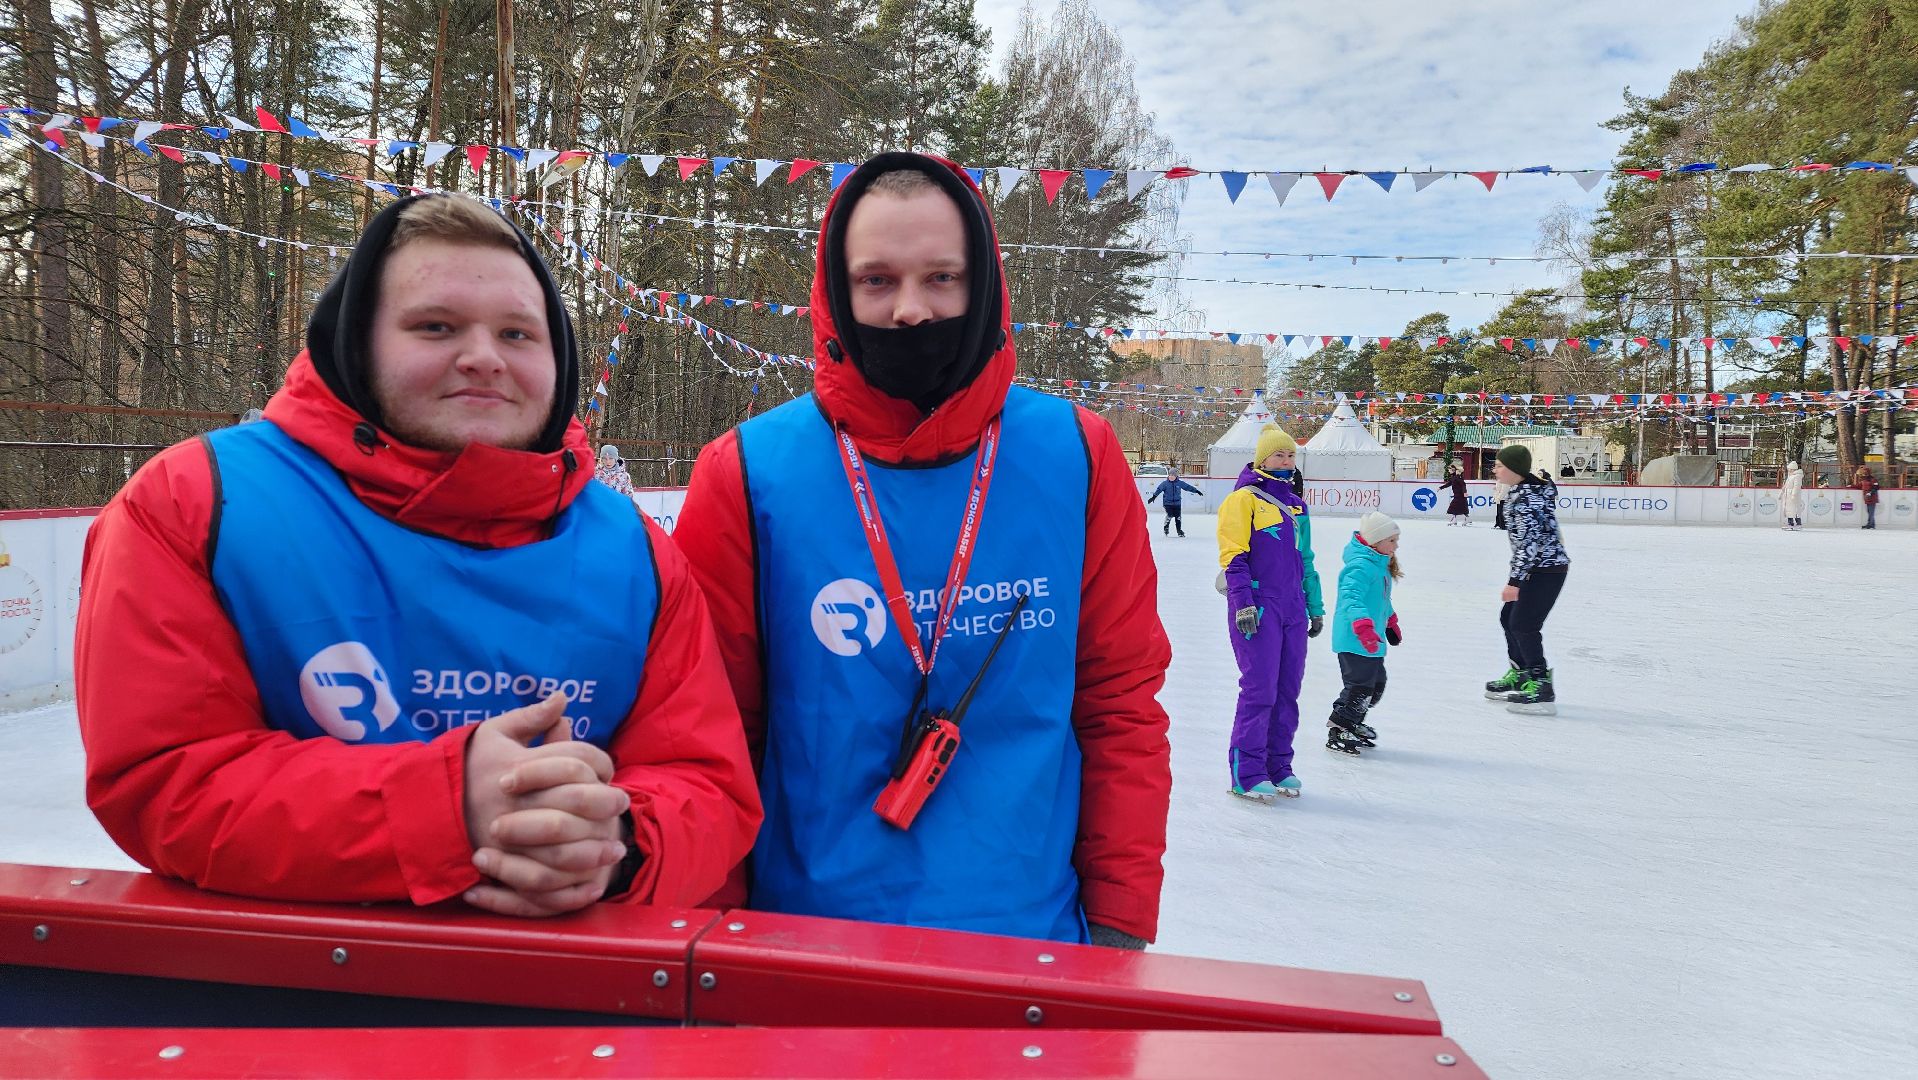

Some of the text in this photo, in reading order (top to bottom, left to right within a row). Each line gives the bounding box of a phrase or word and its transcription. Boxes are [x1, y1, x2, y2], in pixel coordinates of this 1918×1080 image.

[1303, 489, 1381, 508] ИНО 2025
[1558, 497, 1668, 511] ОТЕЧЕСТВО
[411, 669, 597, 704] ЗДОРОВОЕ
